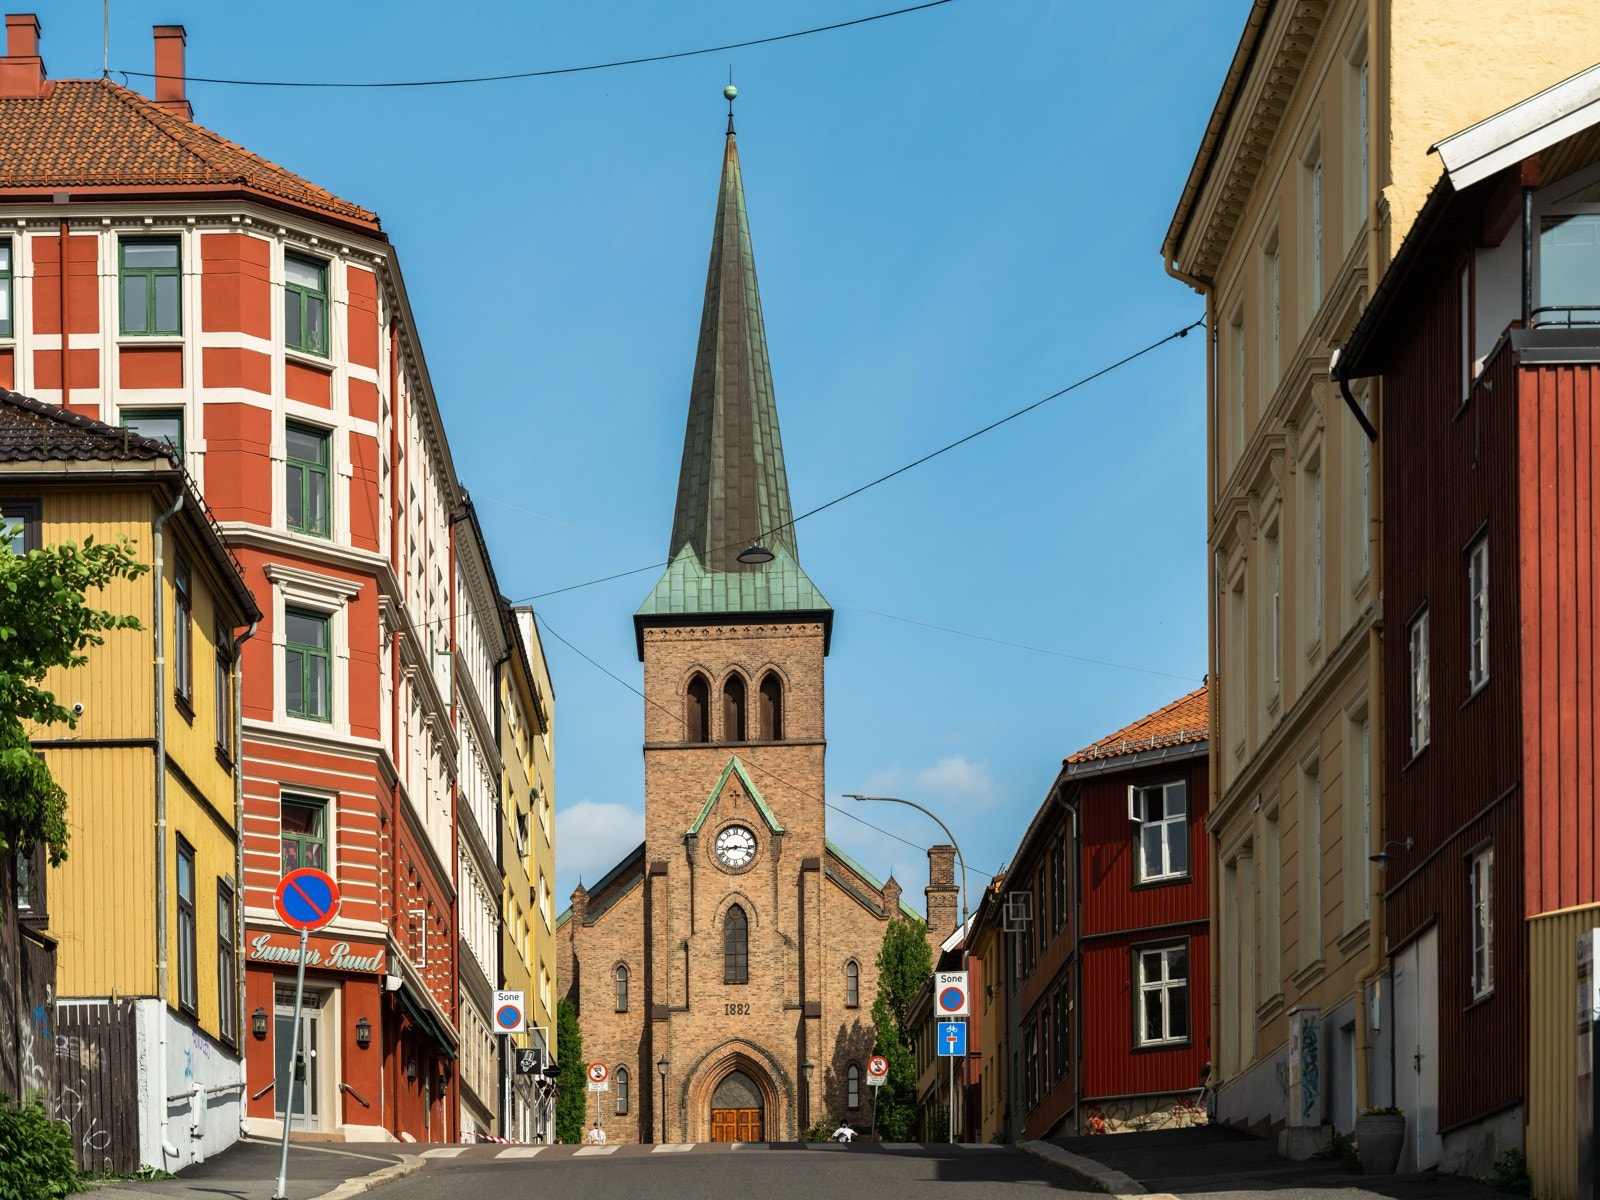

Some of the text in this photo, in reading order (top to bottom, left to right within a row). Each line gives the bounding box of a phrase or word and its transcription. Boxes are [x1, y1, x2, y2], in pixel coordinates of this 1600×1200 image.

[324, 942, 385, 972] Ruud
[940, 974, 963, 983] Sone
[498, 992, 519, 1001] Sone
[724, 1003, 751, 1016] 1882
